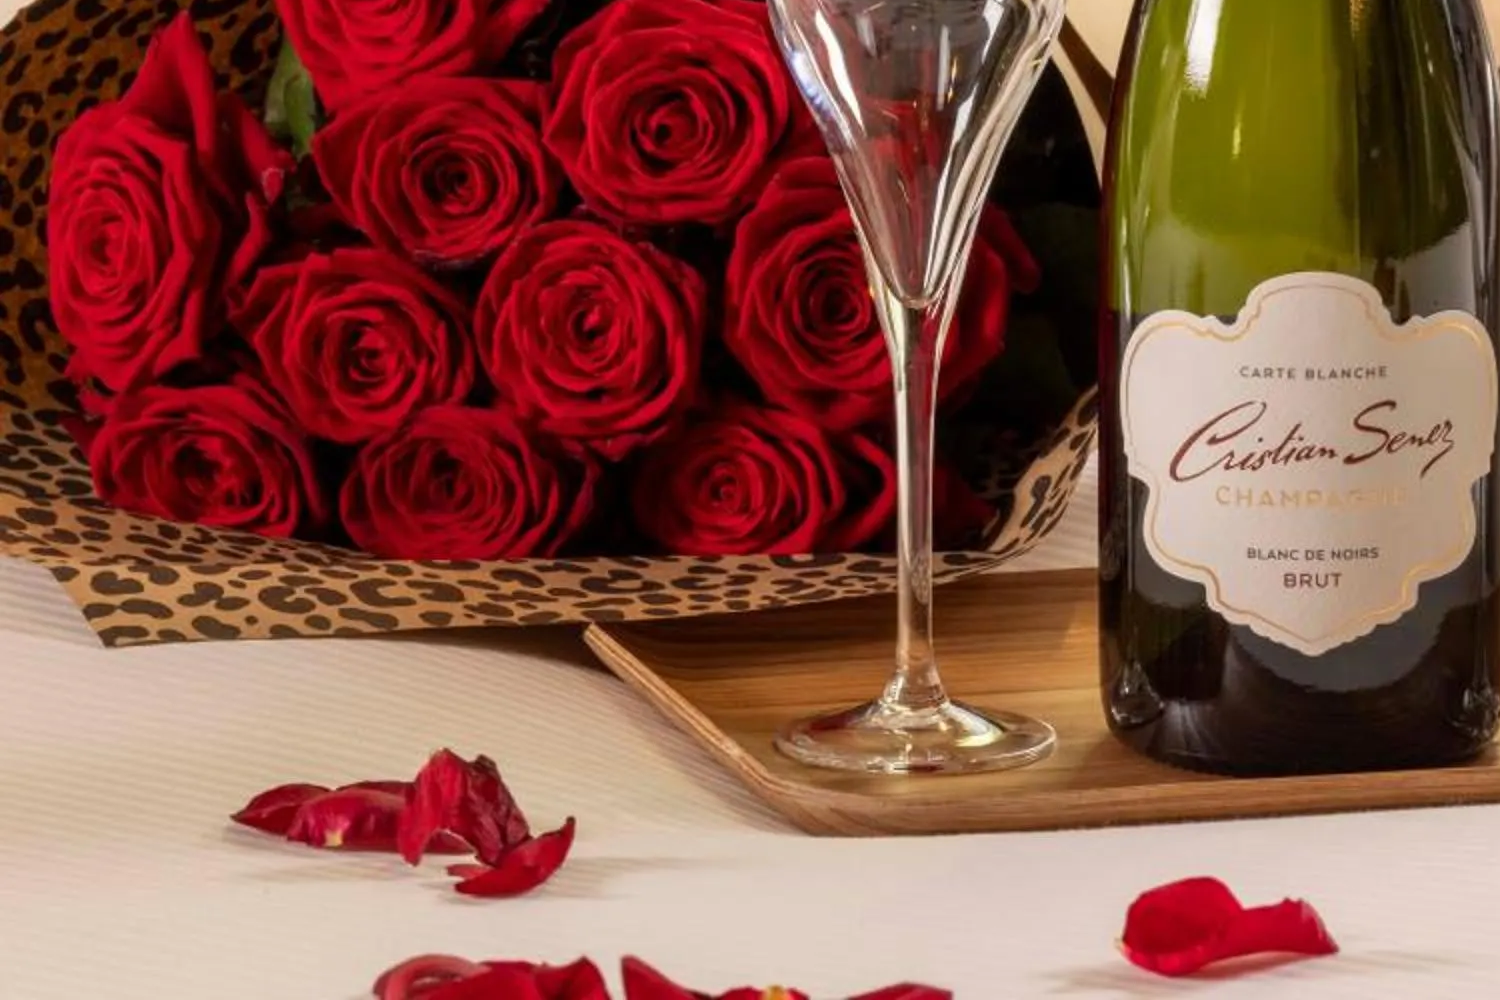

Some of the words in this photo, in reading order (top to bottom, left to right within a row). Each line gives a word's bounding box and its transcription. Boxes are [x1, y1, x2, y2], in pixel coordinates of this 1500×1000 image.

[1239, 364, 1296, 380] CARTE
[1306, 364, 1388, 380] BLANCHE
[1169, 400, 1339, 482] Cristian
[1343, 399, 1455, 478] Senez
[1215, 484, 1407, 508] CHAMPAG
[1246, 546, 1299, 561] BLANC
[1304, 546, 1325, 561] DE
[1330, 546, 1380, 561] NOIRS
[1283, 572, 1343, 589] BRUT
